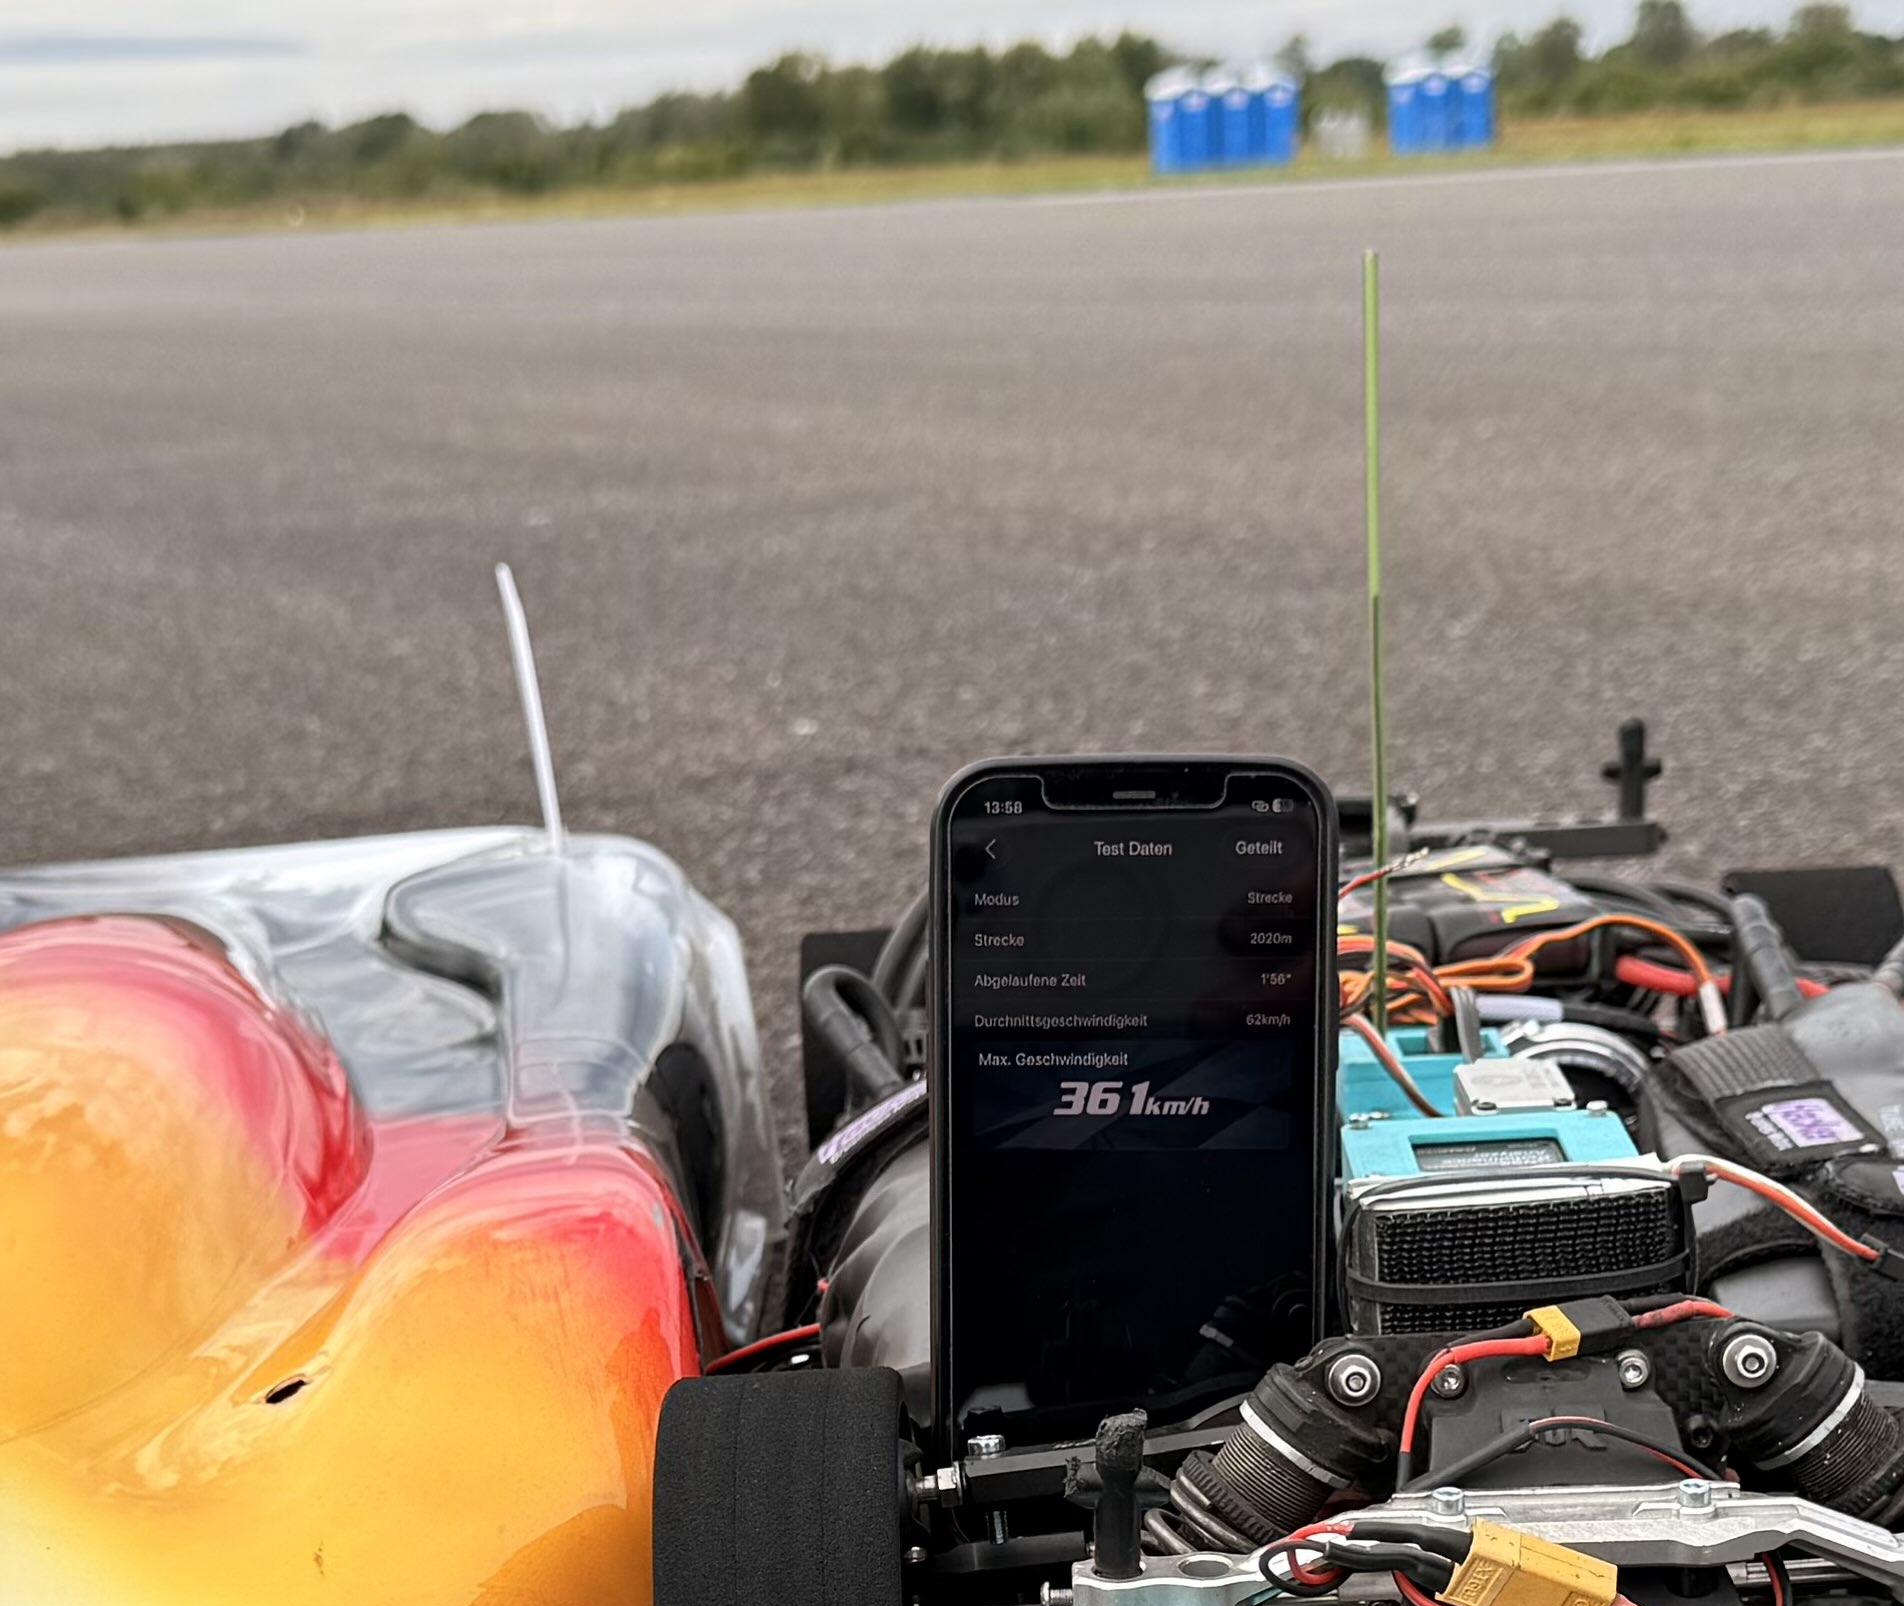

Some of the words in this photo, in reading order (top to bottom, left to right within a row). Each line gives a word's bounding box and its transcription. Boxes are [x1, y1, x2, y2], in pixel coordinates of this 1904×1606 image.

[984, 801, 1023, 814] 13:58
[1094, 841, 1125, 856] Test
[1129, 841, 1173, 856] Daten
[1235, 840, 1283, 856] Geteilt
[974, 893, 1020, 906] Modus
[1247, 892, 1293, 904] Strecke
[974, 933, 1025, 947] Strecke
[1249, 933, 1293, 945] 2020m
[974, 973, 1057, 989] Abgelaufene
[1061, 973, 1087, 987] Zeit
[1246, 1013, 1291, 1026] 62km/h
[978, 1053, 1012, 1067] Max.
[1015, 1053, 1129, 1070] Geschwindigkeit
